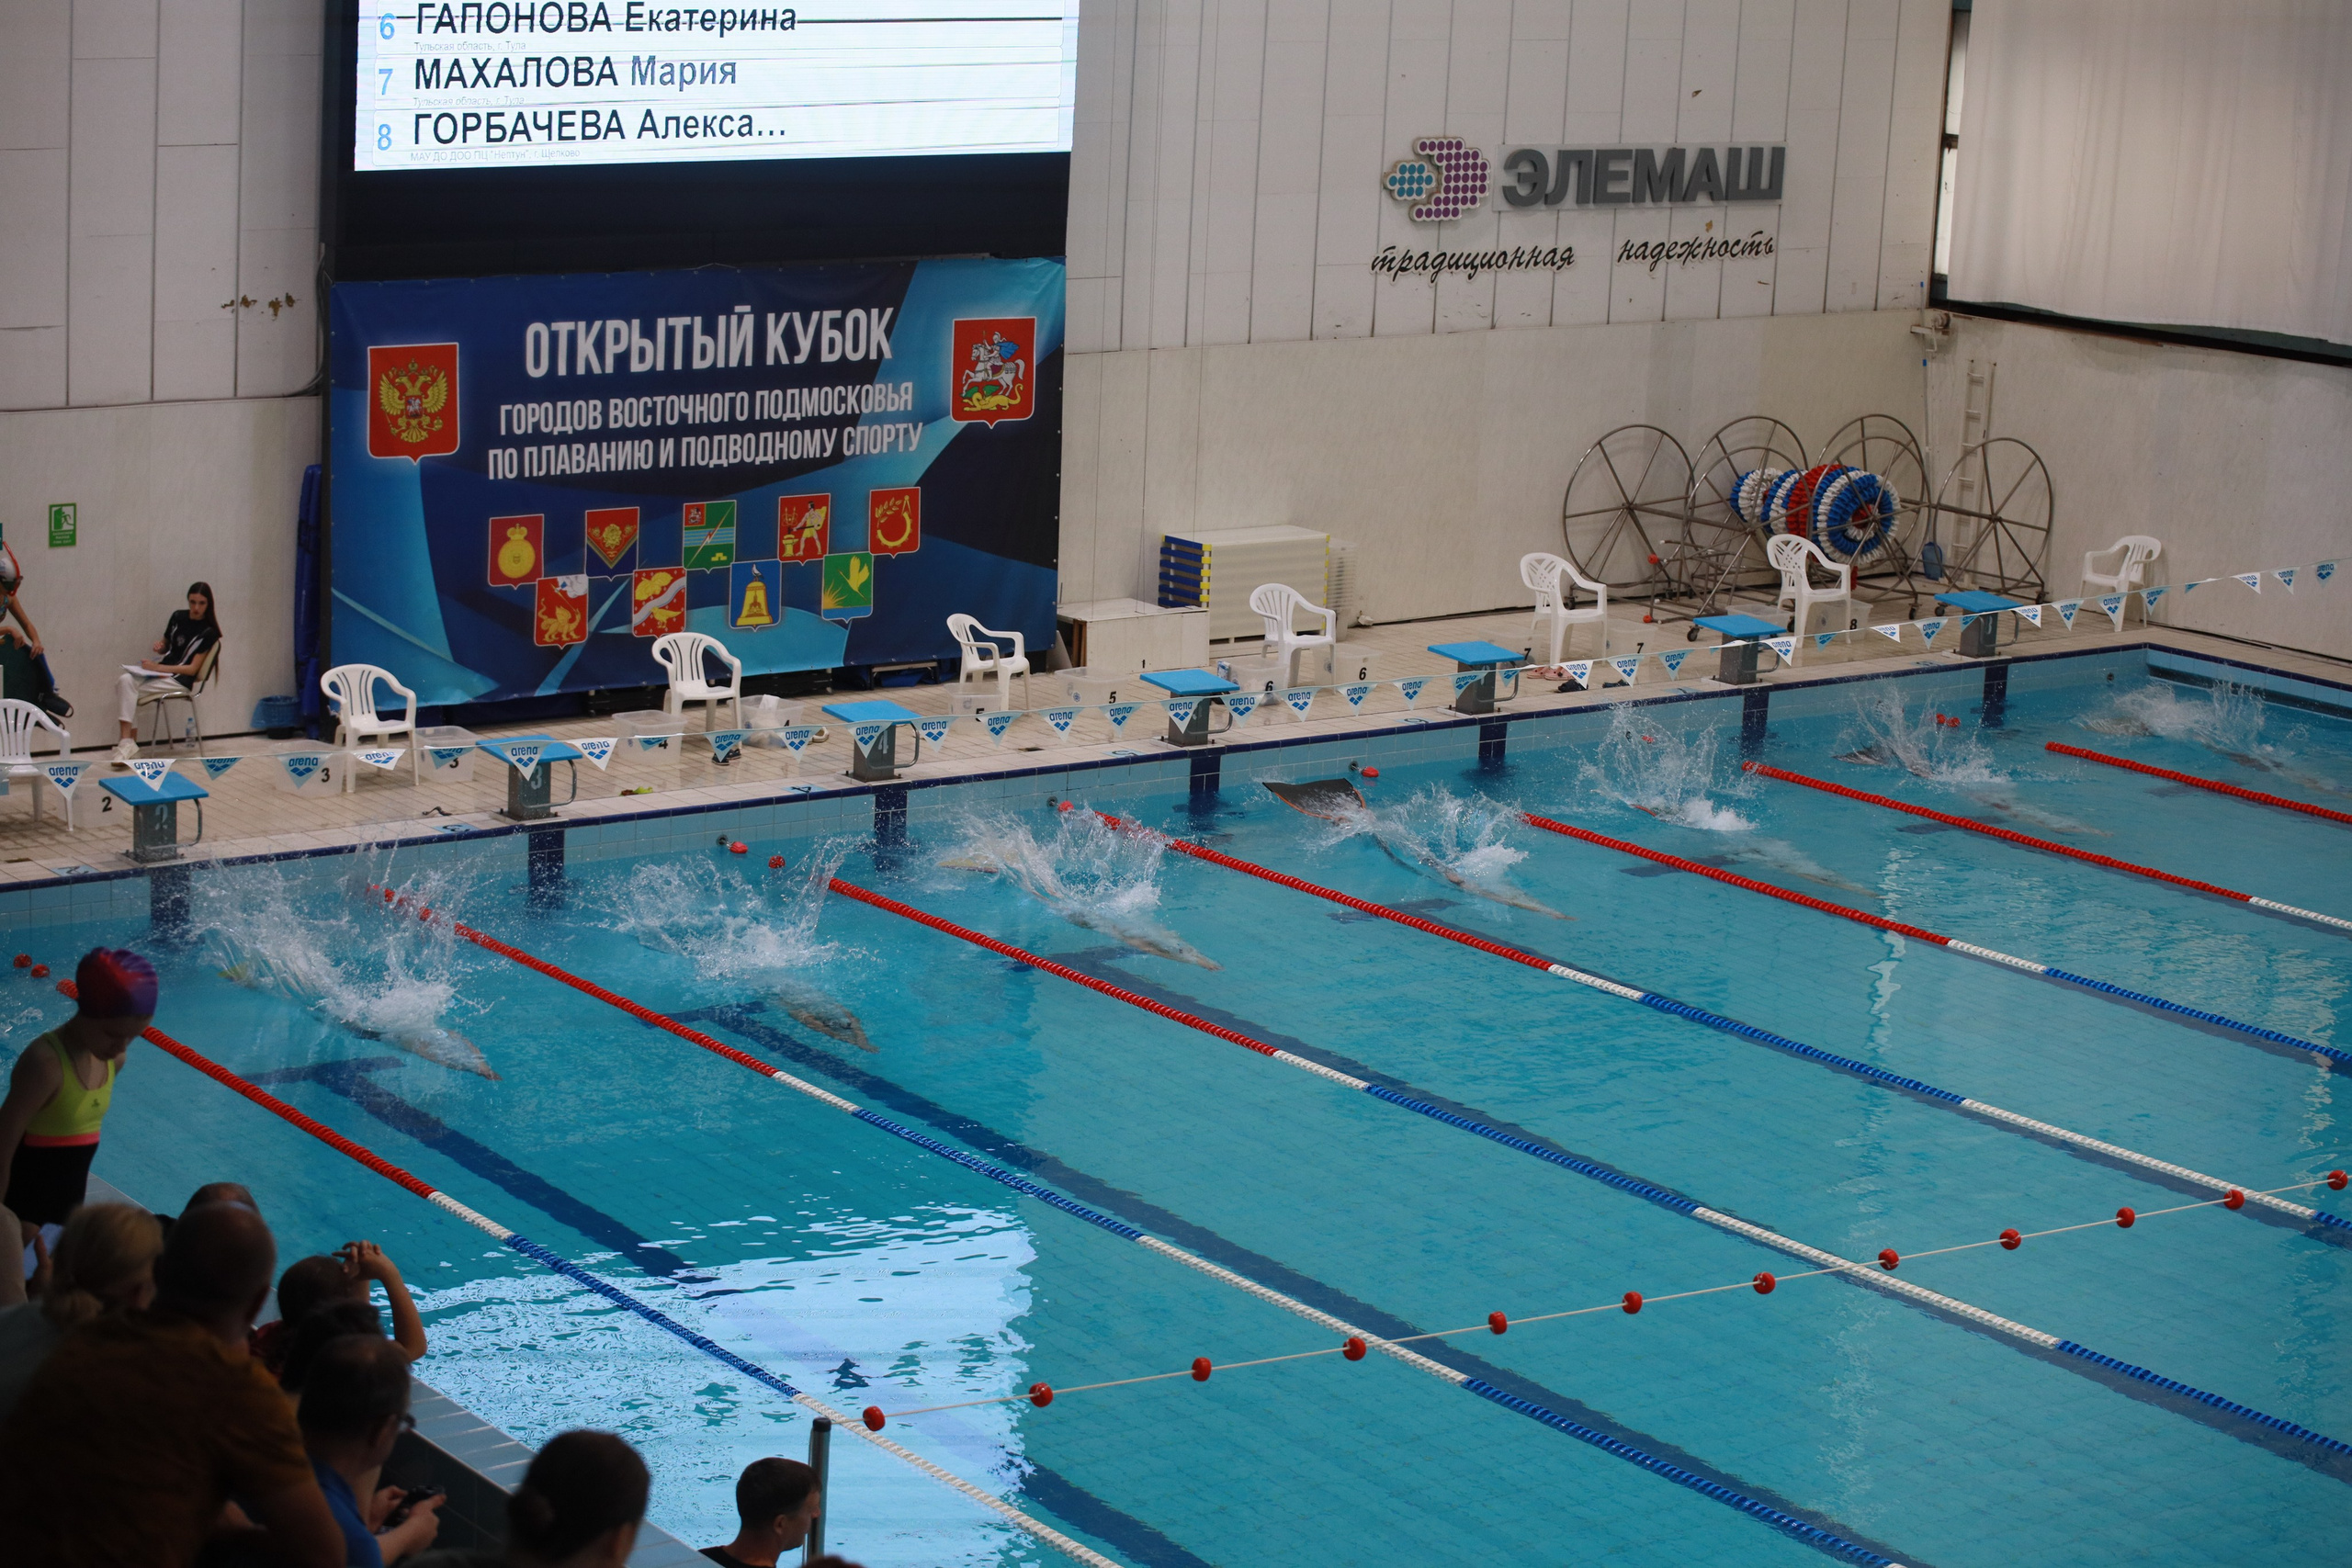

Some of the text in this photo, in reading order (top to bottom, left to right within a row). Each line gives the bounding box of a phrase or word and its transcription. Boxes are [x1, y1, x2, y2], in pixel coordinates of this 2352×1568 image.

[379, 1, 796, 39] 6 ГАПОНОВА Екатерина
[413, 41, 455, 52] Тульская
[505, 40, 526, 51] Тула
[378, 55, 737, 96] 7 МАХАЛОВА Мария
[377, 108, 786, 151] 8 ГОРБАЧЕВА Алекса...
[411, 152, 432, 162] МАУ
[433, 152, 447, 162] ДО
[450, 151, 471, 162] ДОО
[541, 149, 581, 158] Щелково
[1503, 146, 1786, 208] ЭЛЕМАШ
[1371, 231, 1774, 283] традиционная надежность
[525, 305, 894, 378] ОТКРЫТЫЙ КУБОК
[500, 381, 913, 436] ГОРОДОВ ВОСТОЧНОГО ПОДМОСКОВЬЯ
[488, 422, 923, 480] ПО ПЛАВАНИЮ И ПОДВОДНОМУ СПОРТУ
[1637, 642, 1645, 653] 7
[1523, 648, 1532, 660] 7
[1665, 652, 1685, 662] arena
[1617, 659, 1636, 668] arena
[1359, 667, 1367, 681] 6
[1347, 686, 1367, 696] arena
[1402, 681, 1422, 691] arena
[1108, 691, 1116, 704] 5
[1229, 696, 1255, 706] arena
[1288, 691, 1311, 701] arena
[1109, 706, 1132, 716] arena
[1170, 701, 1193, 711] arena
[1049, 711, 1072, 721] arena
[922, 720, 947, 730] arena
[988, 716, 1010, 727] arena
[785, 729, 810, 739] arena
[856, 726, 880, 736] arena
[715, 733, 741, 743] arena
[582, 740, 610, 750] arena
[511, 746, 538, 756] arena
[288, 757, 318, 766] arena
[49, 766, 78, 776] arena
[322, 767, 331, 783] 3
[101, 796, 112, 813] 2
